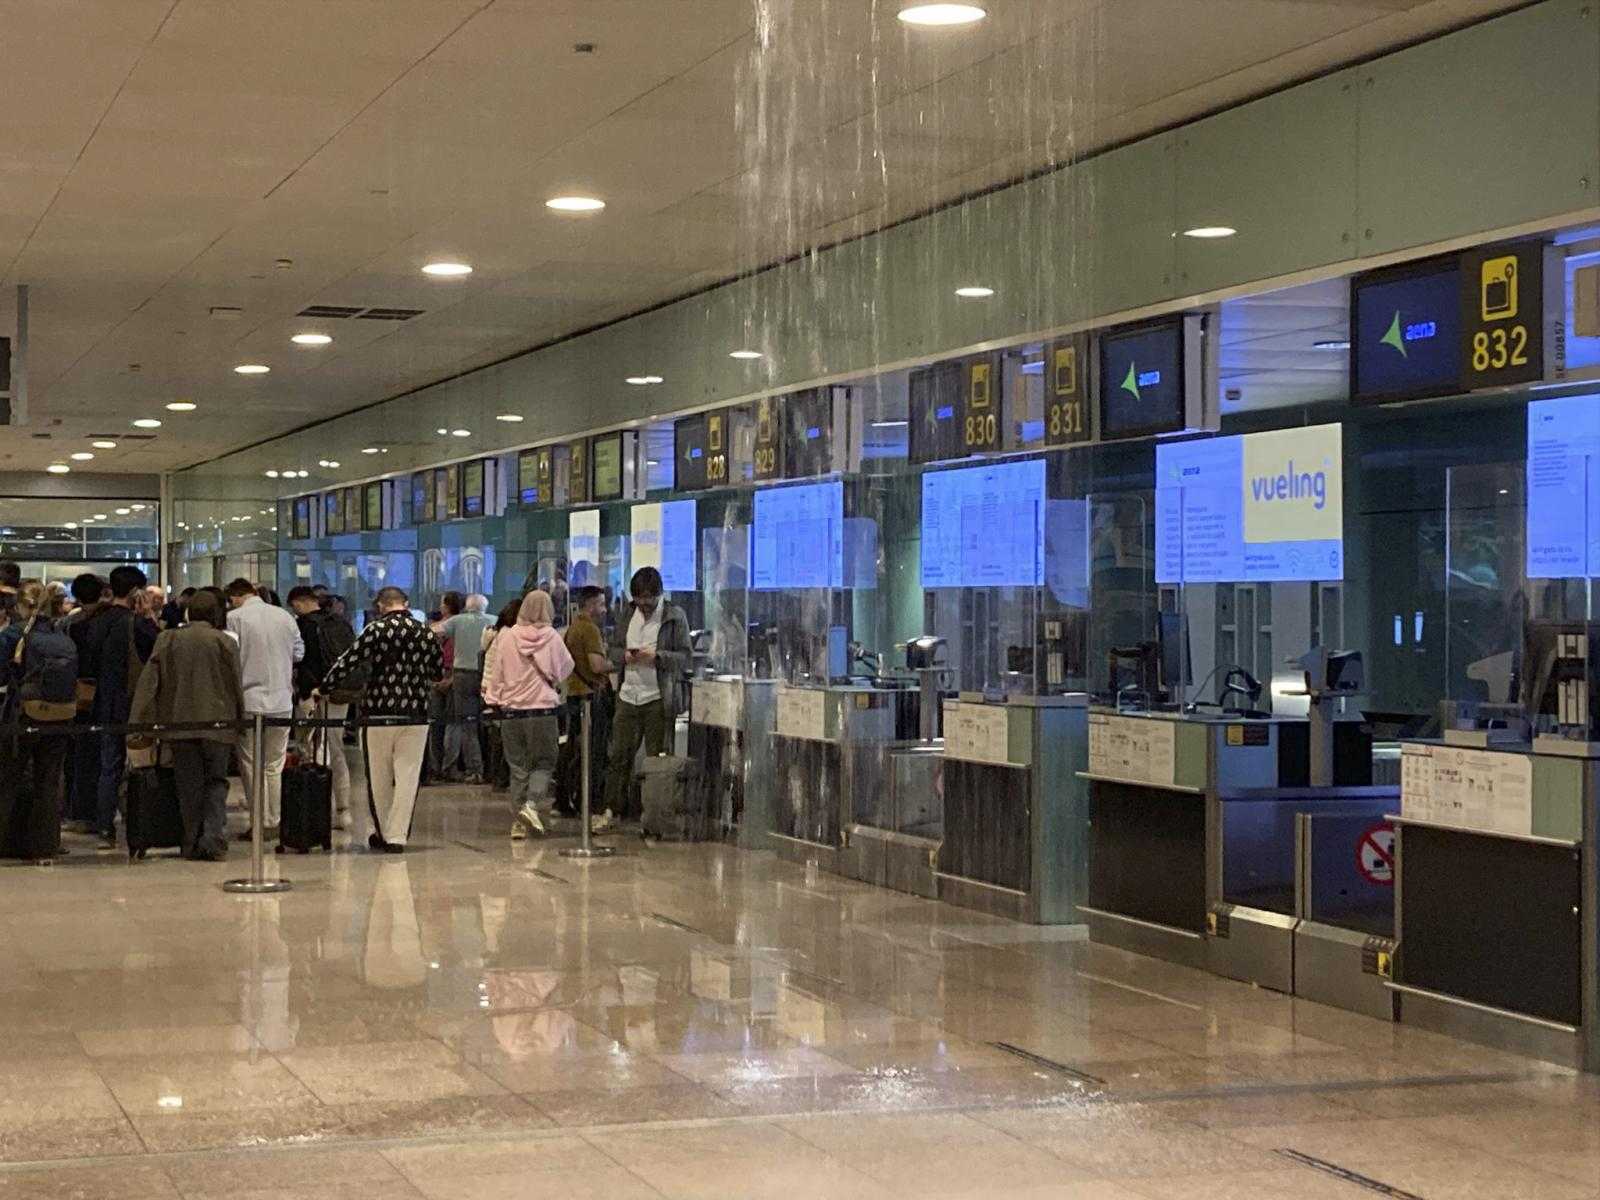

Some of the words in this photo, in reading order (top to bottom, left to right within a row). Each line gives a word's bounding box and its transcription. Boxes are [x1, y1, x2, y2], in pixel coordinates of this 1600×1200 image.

[1472, 325, 1528, 371] 832
[965, 413, 996, 447] 830
[1050, 401, 1082, 436] 831
[706, 454, 725, 480] 828
[754, 448, 775, 474] 829
[1251, 459, 1327, 510] vueling
